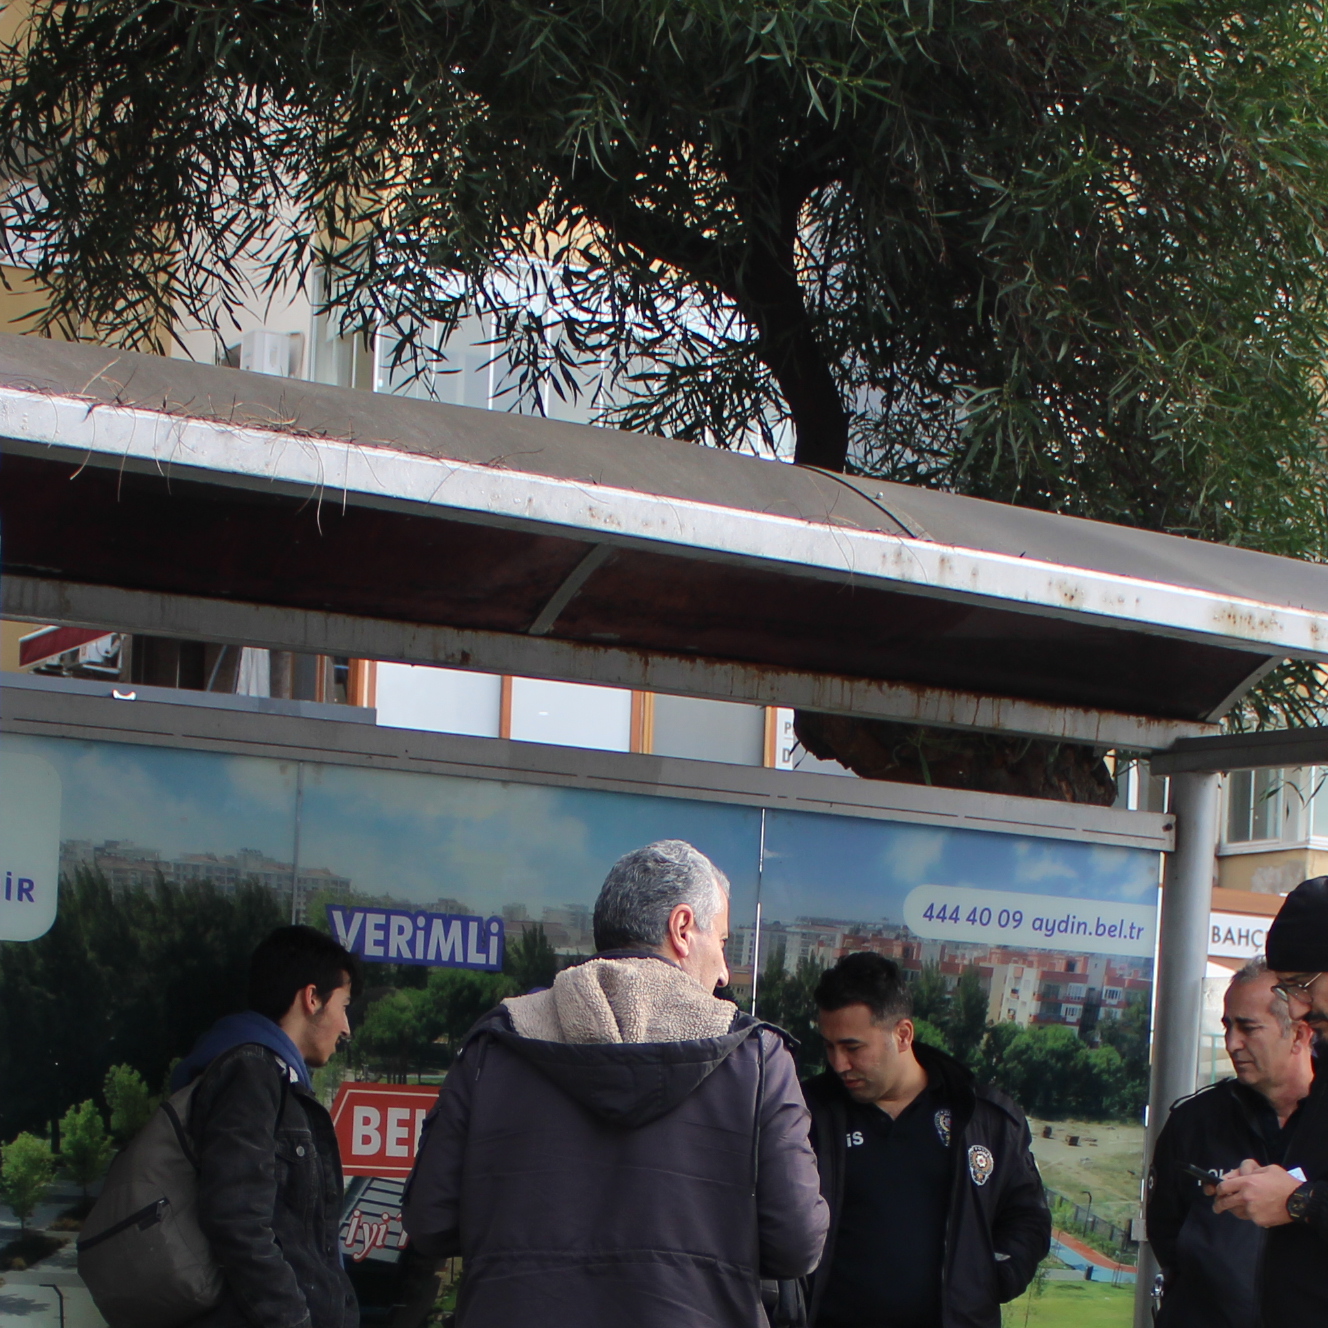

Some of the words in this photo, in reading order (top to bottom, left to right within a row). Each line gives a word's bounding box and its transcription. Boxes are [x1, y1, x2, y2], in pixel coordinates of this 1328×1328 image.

[923, 902, 960, 924] 444
[966, 906, 992, 926] 40
[998, 909, 1023, 930] 09
[1032, 914, 1144, 941] aydin.bel.tr
